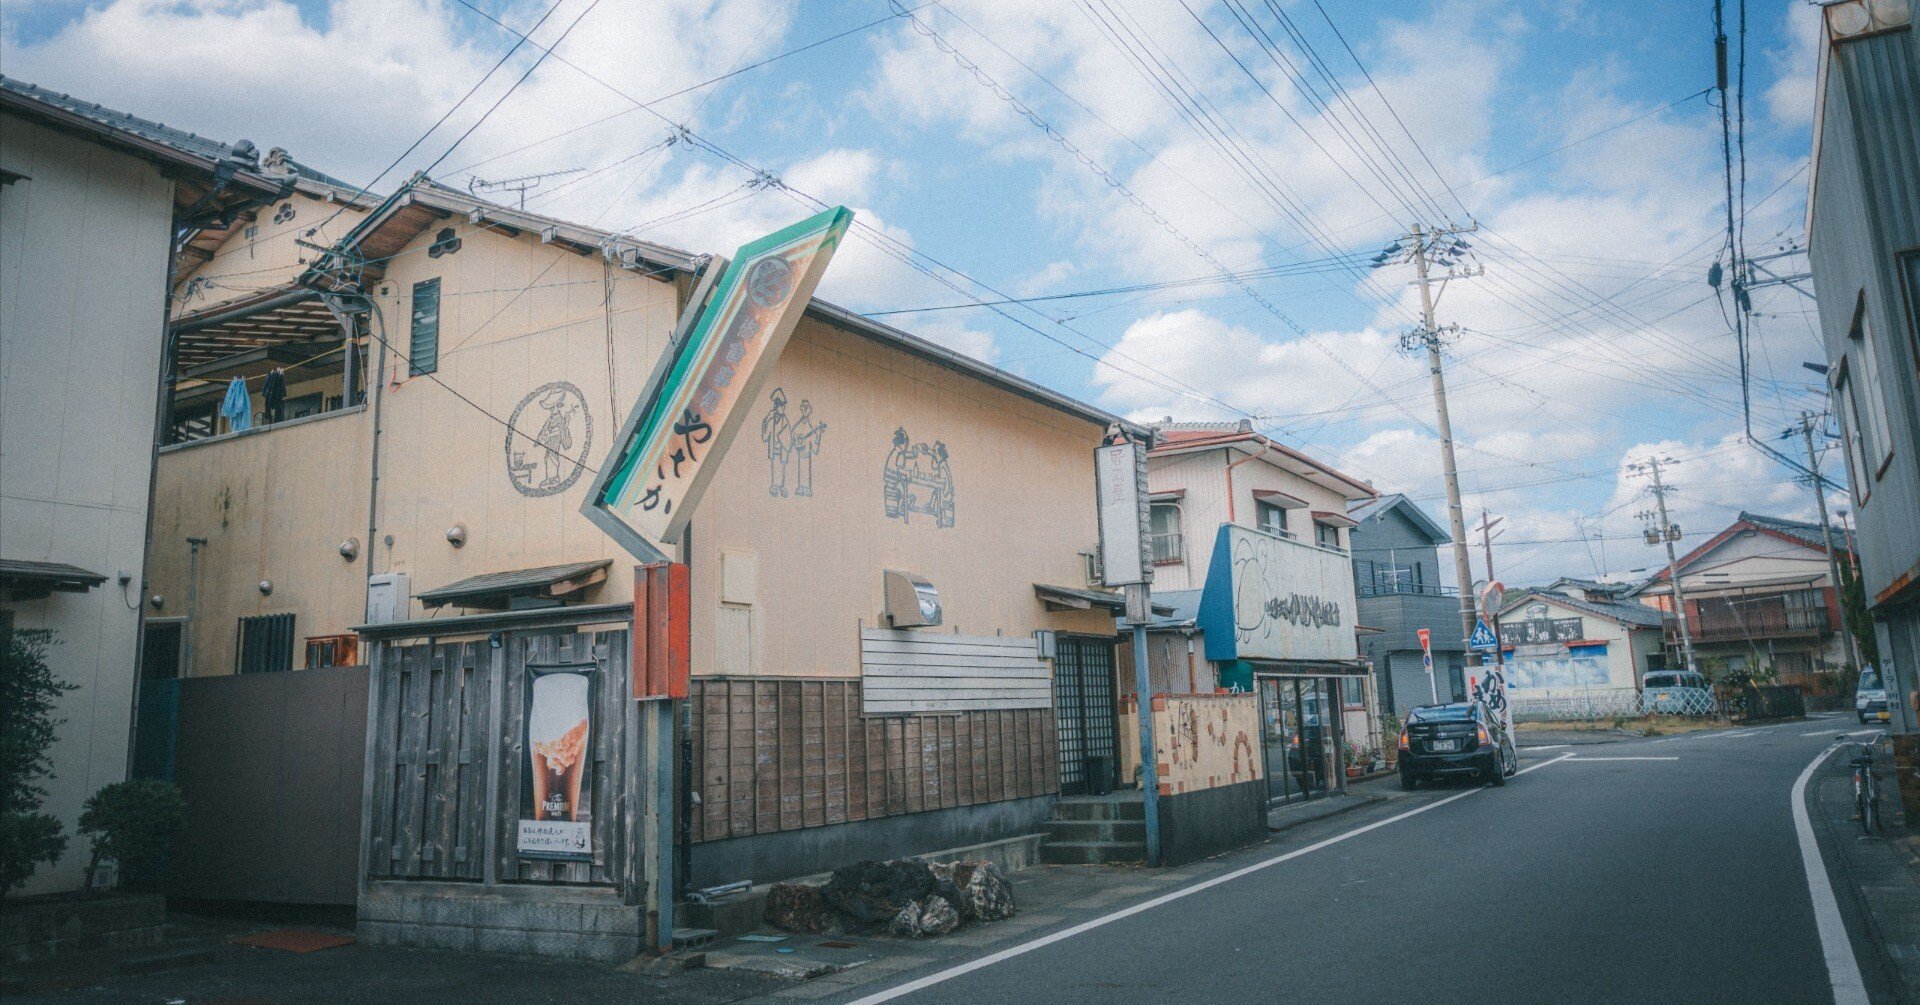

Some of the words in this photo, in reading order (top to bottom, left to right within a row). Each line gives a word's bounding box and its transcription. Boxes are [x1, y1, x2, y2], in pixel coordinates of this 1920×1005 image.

[634, 410, 713, 515] やさか
[542, 800, 570, 812] PREMIUM
